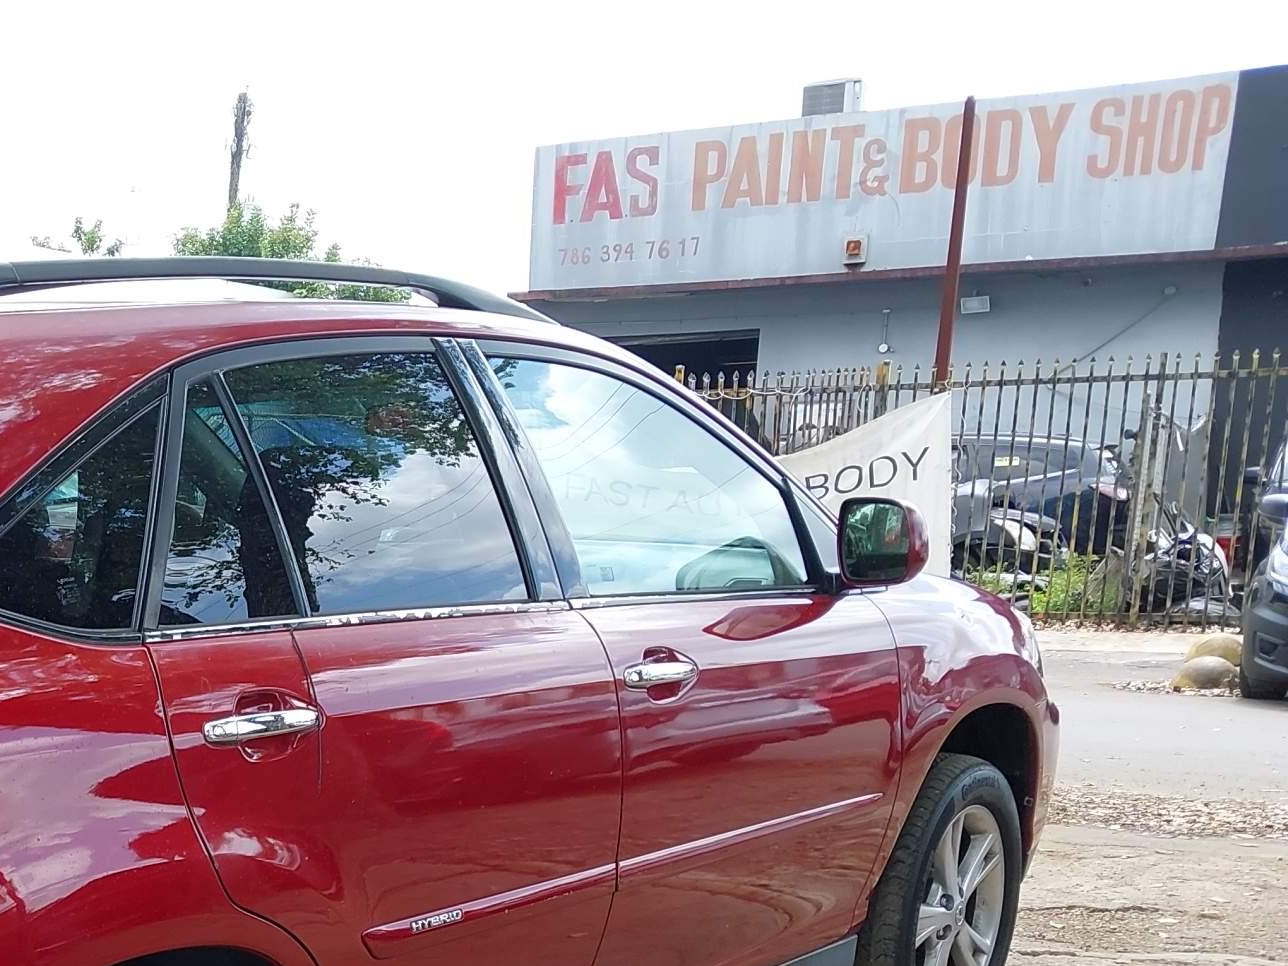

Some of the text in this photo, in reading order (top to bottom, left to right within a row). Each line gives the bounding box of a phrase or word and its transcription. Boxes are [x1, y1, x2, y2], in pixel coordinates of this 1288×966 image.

[691, 124, 866, 211] PAINT
[859, 138, 890, 197] &
[898, 102, 1077, 195] BODY
[1085, 83, 1232, 180] SHOP
[558, 247, 592, 267] 786
[599, 242, 635, 263] 394
[565, 472, 661, 510] FAST
[805, 446, 931, 501] BODY
[411, 909, 463, 933] HYBRID
